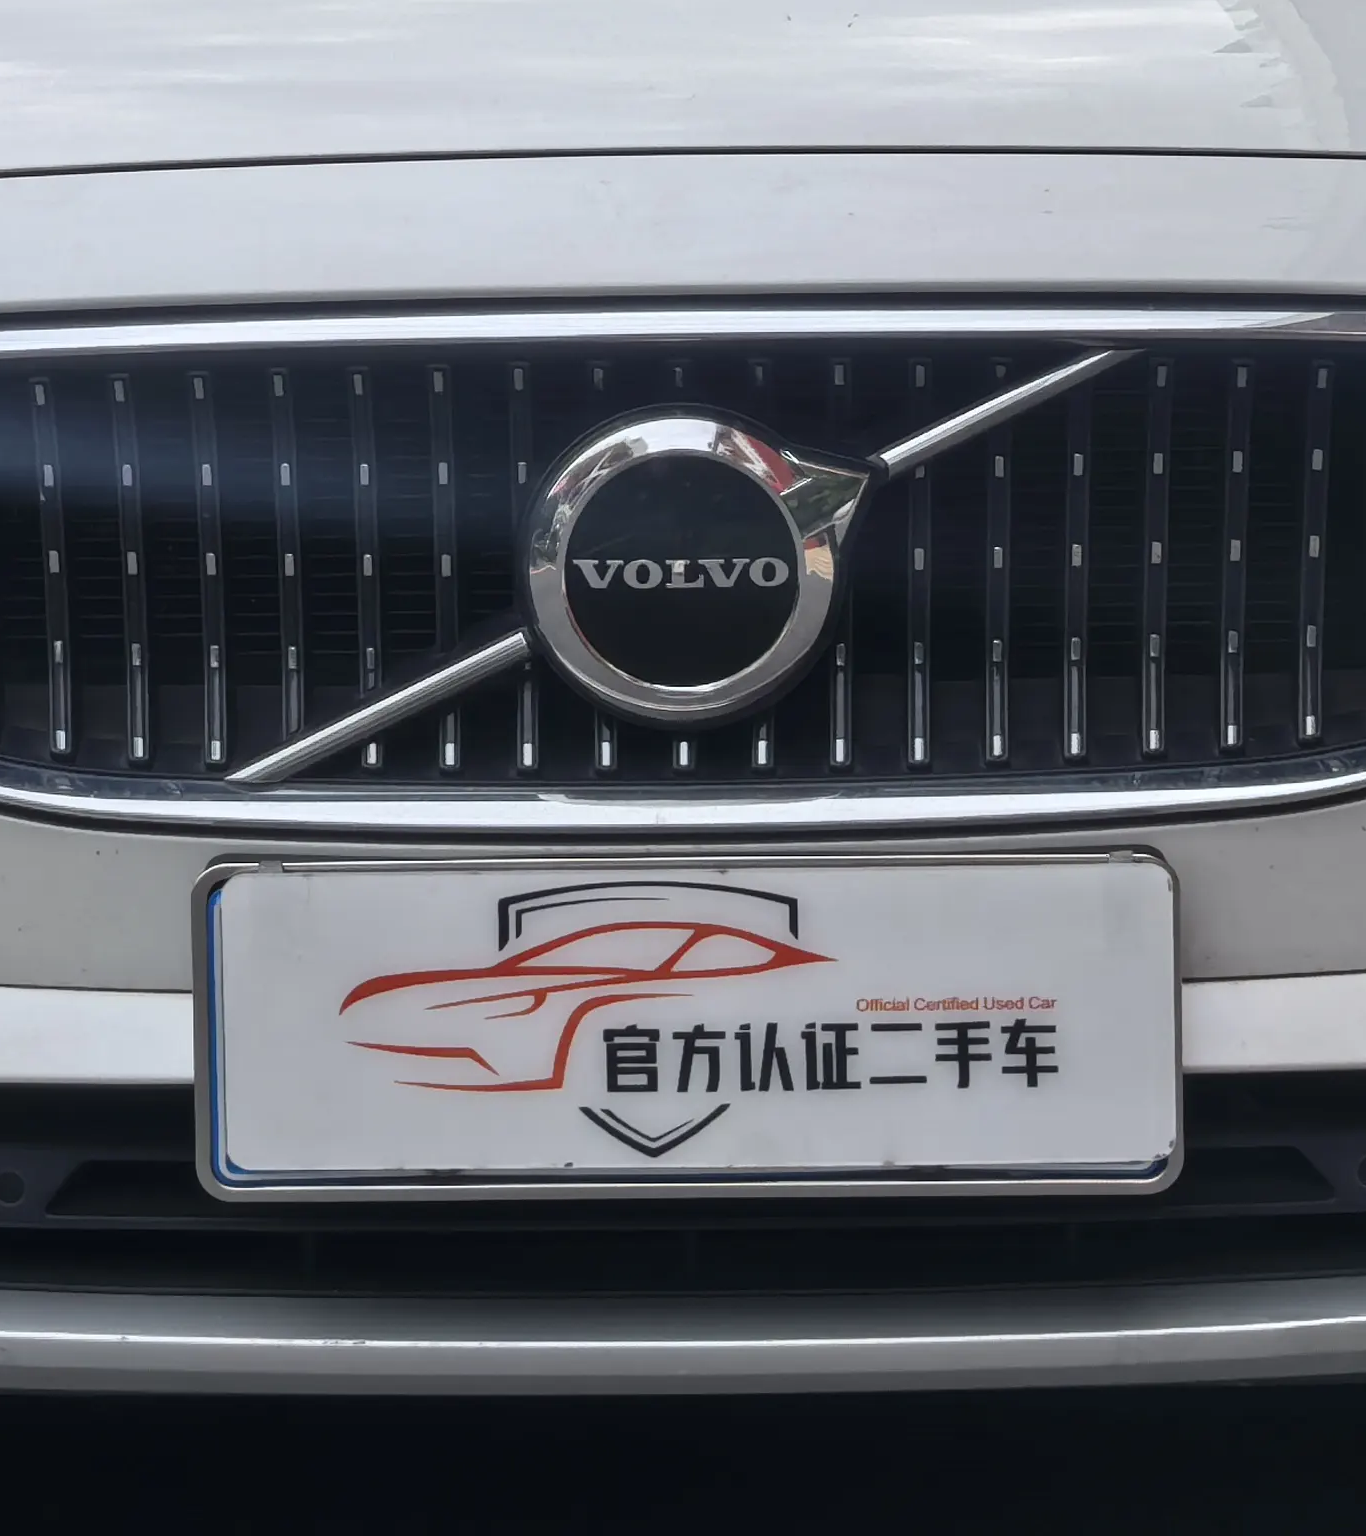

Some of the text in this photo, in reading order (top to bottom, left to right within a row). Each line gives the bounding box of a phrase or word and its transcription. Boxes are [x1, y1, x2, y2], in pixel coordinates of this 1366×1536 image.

[572, 557, 790, 590] VOLVO
[856, 996, 1058, 1012] Official Certified Used Car
[603, 1018, 1059, 1093] 官方认证二手车
